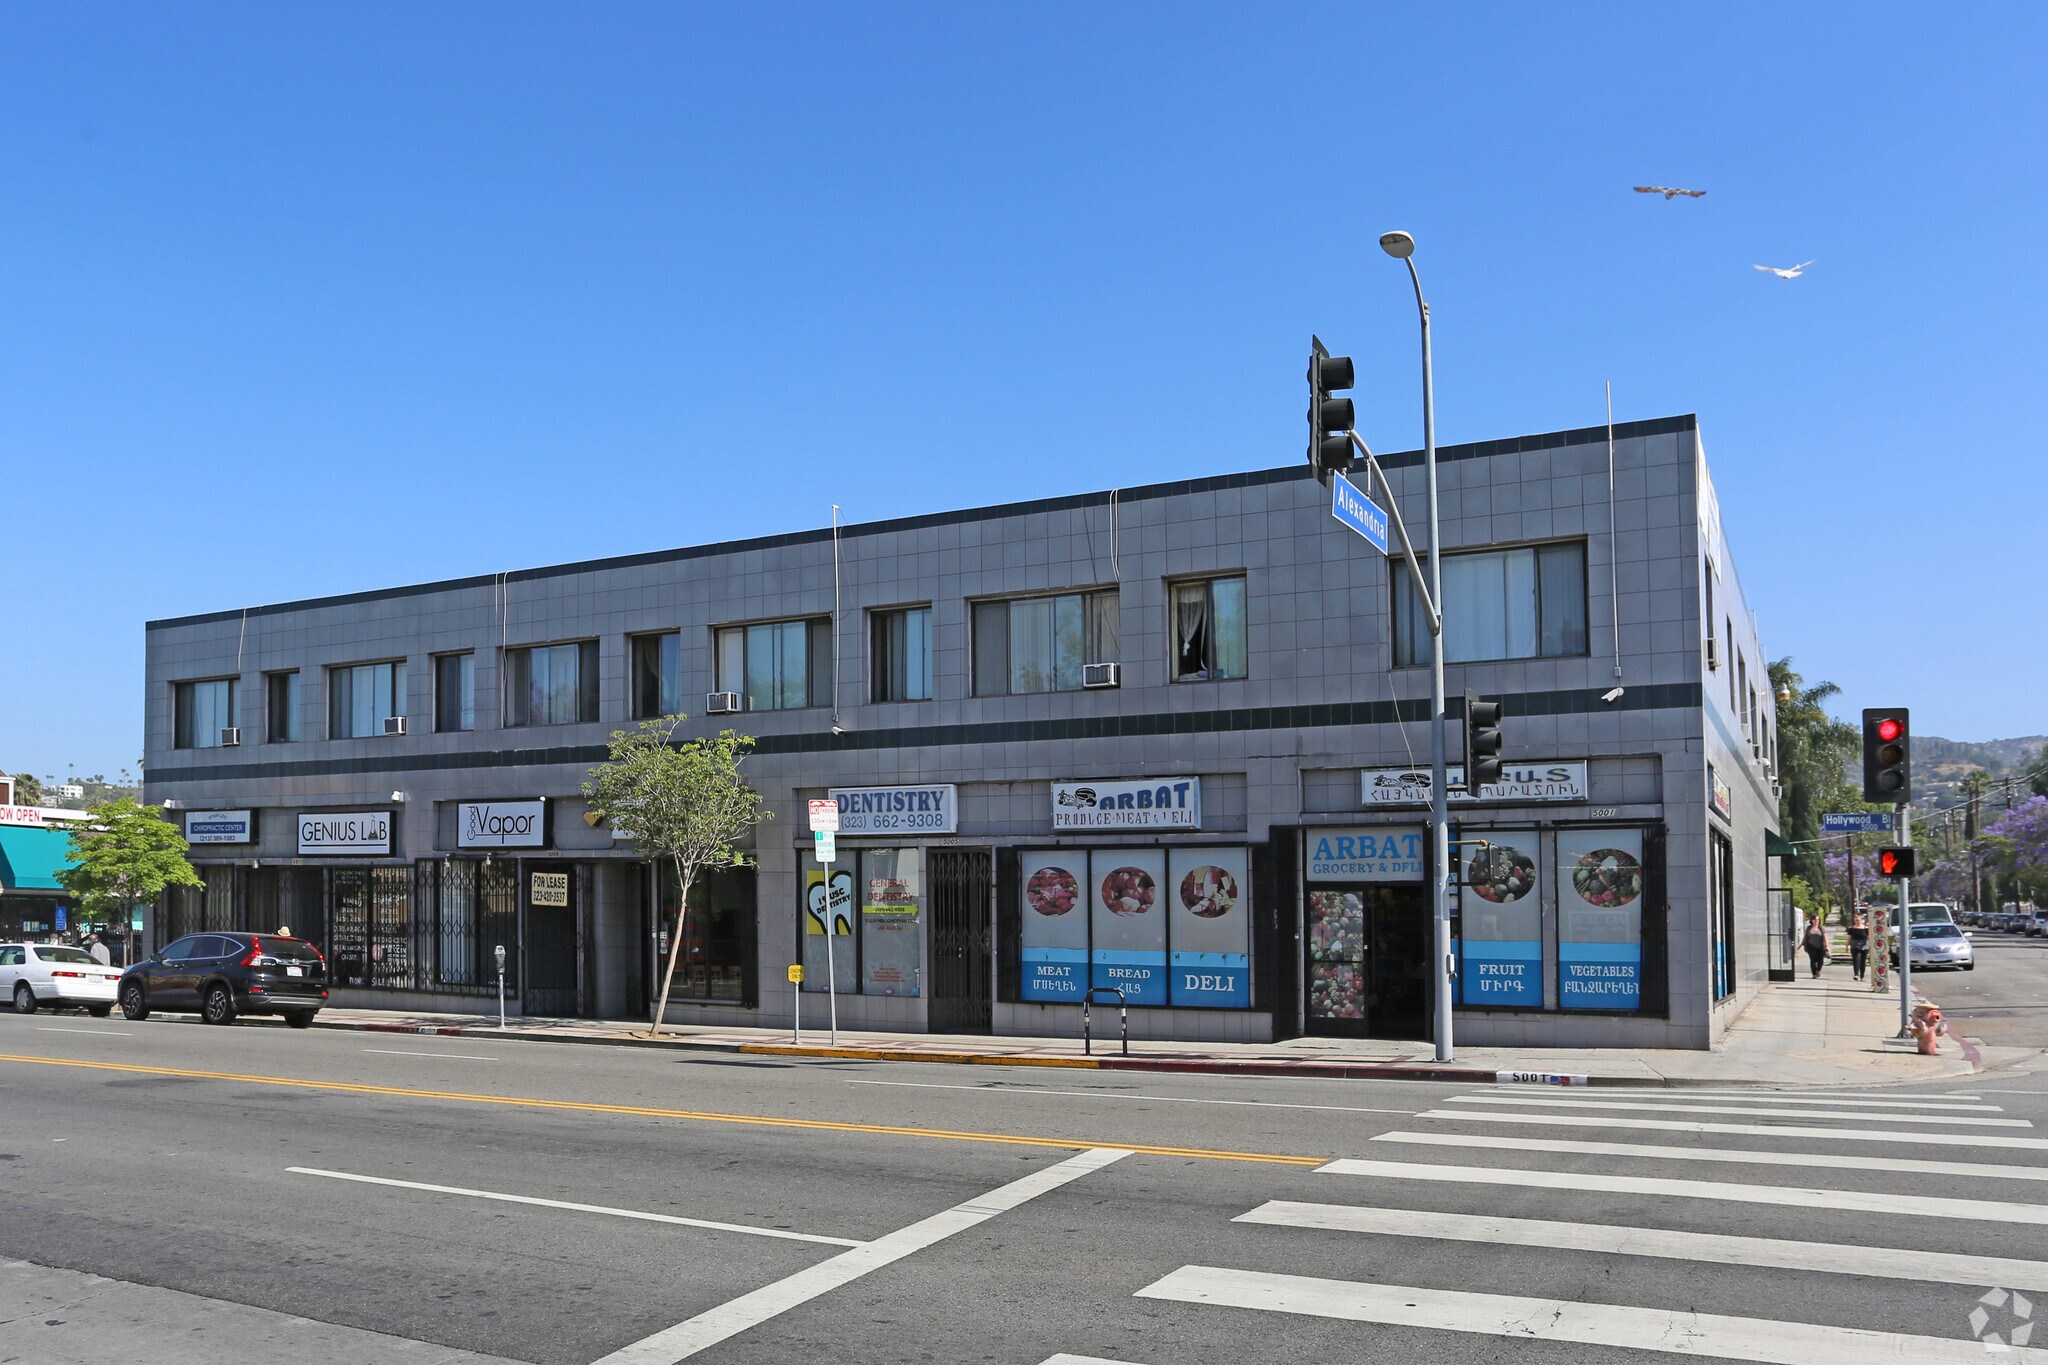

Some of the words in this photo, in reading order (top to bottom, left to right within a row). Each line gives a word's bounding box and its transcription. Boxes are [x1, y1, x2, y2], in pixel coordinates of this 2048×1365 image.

[1338, 486, 1385, 540] Alexandria
[1100, 782, 1190, 810] ARBAT
[836, 791, 944, 814] DENTISTRY
[0, 807, 13, 821] OW
[16, 808, 41, 822] OPEN
[810, 806, 819, 814] NO
[1592, 808, 1615, 818] 5001
[476, 806, 536, 844] Vapor
[841, 815, 867, 829] (323)
[873, 813, 943, 828] 662-9308
[1826, 815, 1871, 827] Hollywood
[194, 824, 225, 832] CHIROPRACTIC
[302, 821, 356, 842] GENIUS
[1312, 834, 1424, 860] ARBAT
[1313, 862, 1376, 874] GROCERY
[1378, 862, 1388, 873] &
[534, 875, 545, 888] FOR
[546, 876, 566, 889] LEASE
[870, 879, 909, 888] GENERAL
[829, 887, 846, 900] USC
[868, 892, 914, 902] DENTISTRY
[816, 893, 851, 914] DETISTRY
[1037, 966, 1071, 976] MEAT
[1108, 968, 1151, 979] BREAD
[1479, 964, 1525, 976] FRUIT
[1570, 965, 1634, 977] VEGETABLES
[1185, 974, 1235, 992] DELI
[1512, 1072, 1549, 1083] 5001
